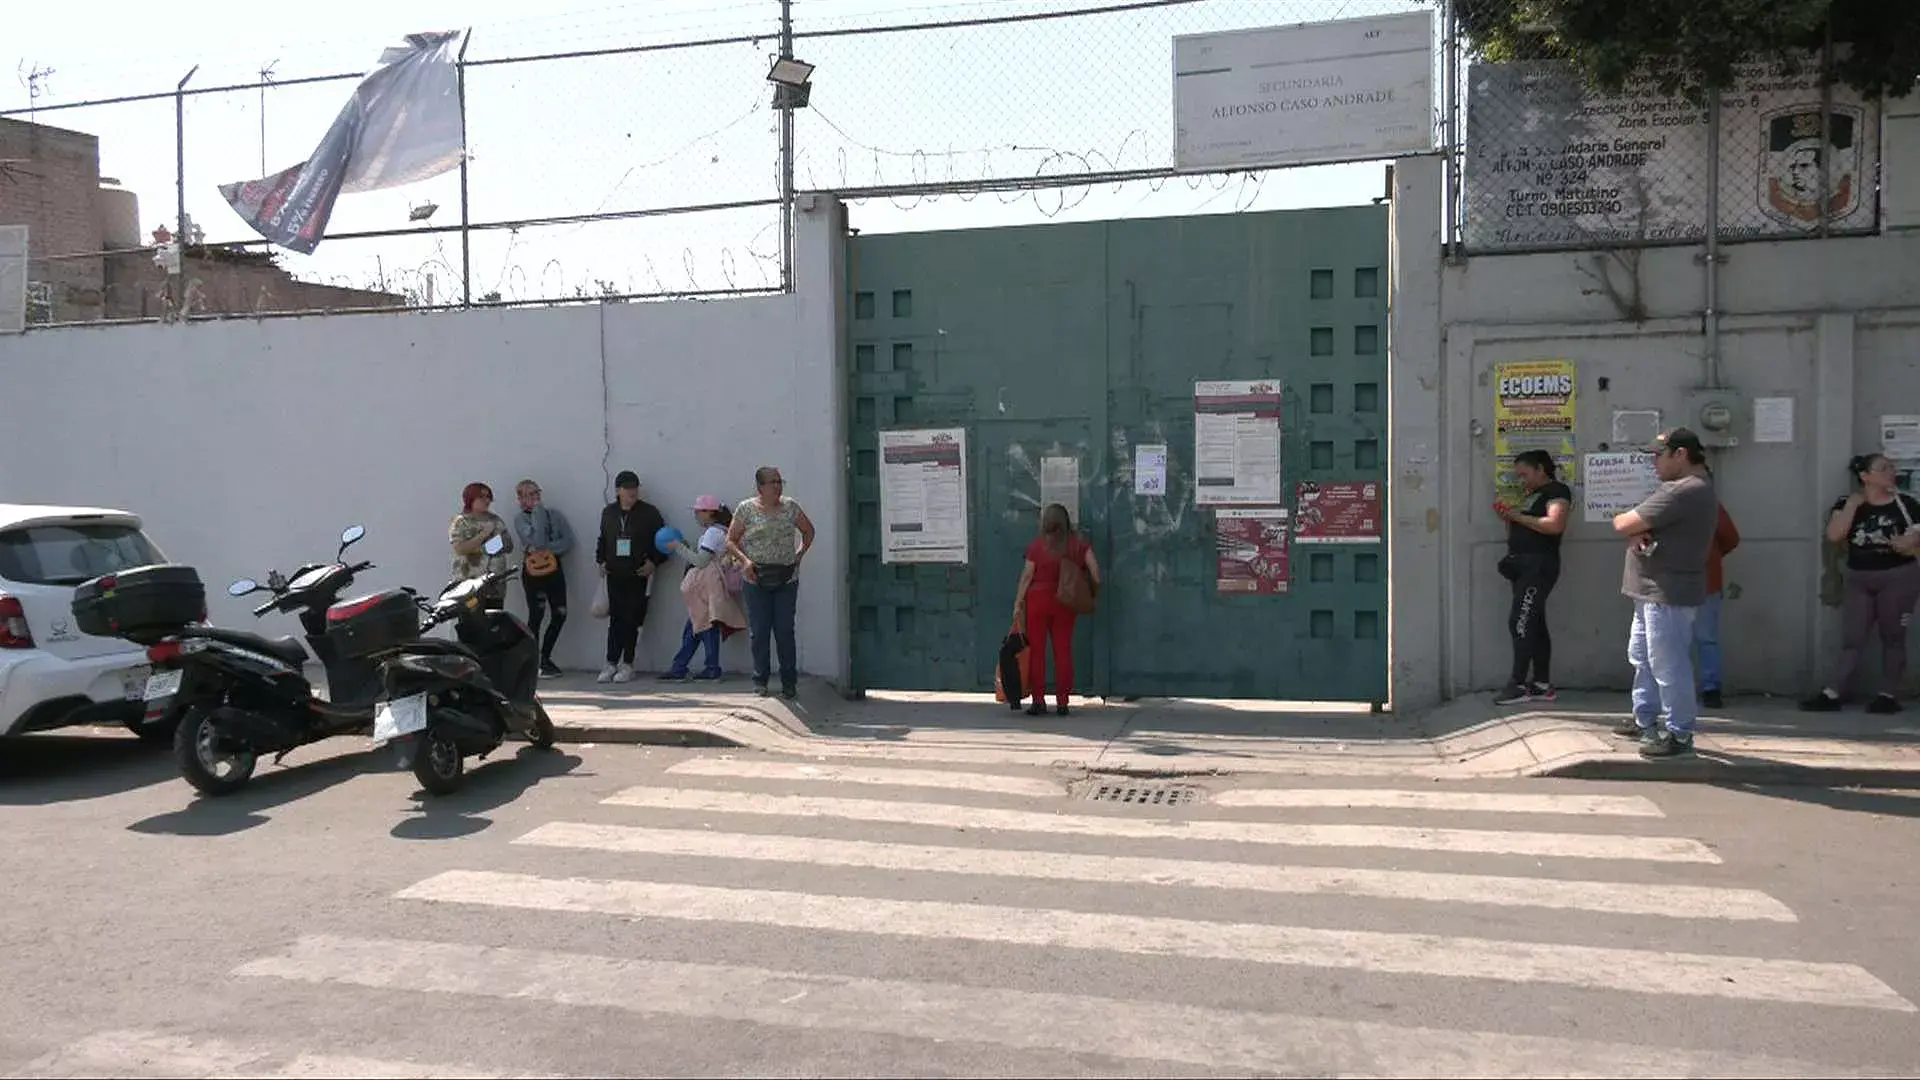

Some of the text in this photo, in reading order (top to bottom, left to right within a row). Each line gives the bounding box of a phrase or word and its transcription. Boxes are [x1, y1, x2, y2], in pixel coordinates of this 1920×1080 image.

[1258, 74, 1344, 94] SECUNDARIA
[1211, 90, 1395, 119] ALFONSO CASO ANDRADE
[1616, 114, 1648, 129] Zona
[1651, 111, 1698, 127] Escolar
[1613, 135, 1667, 152] General
[1588, 152, 1649, 168] ANDRADE
[1559, 170, 1589, 186] 324
[1508, 184, 1620, 203] Turno Matutino
[1499, 374, 1572, 397] ECOEMS
